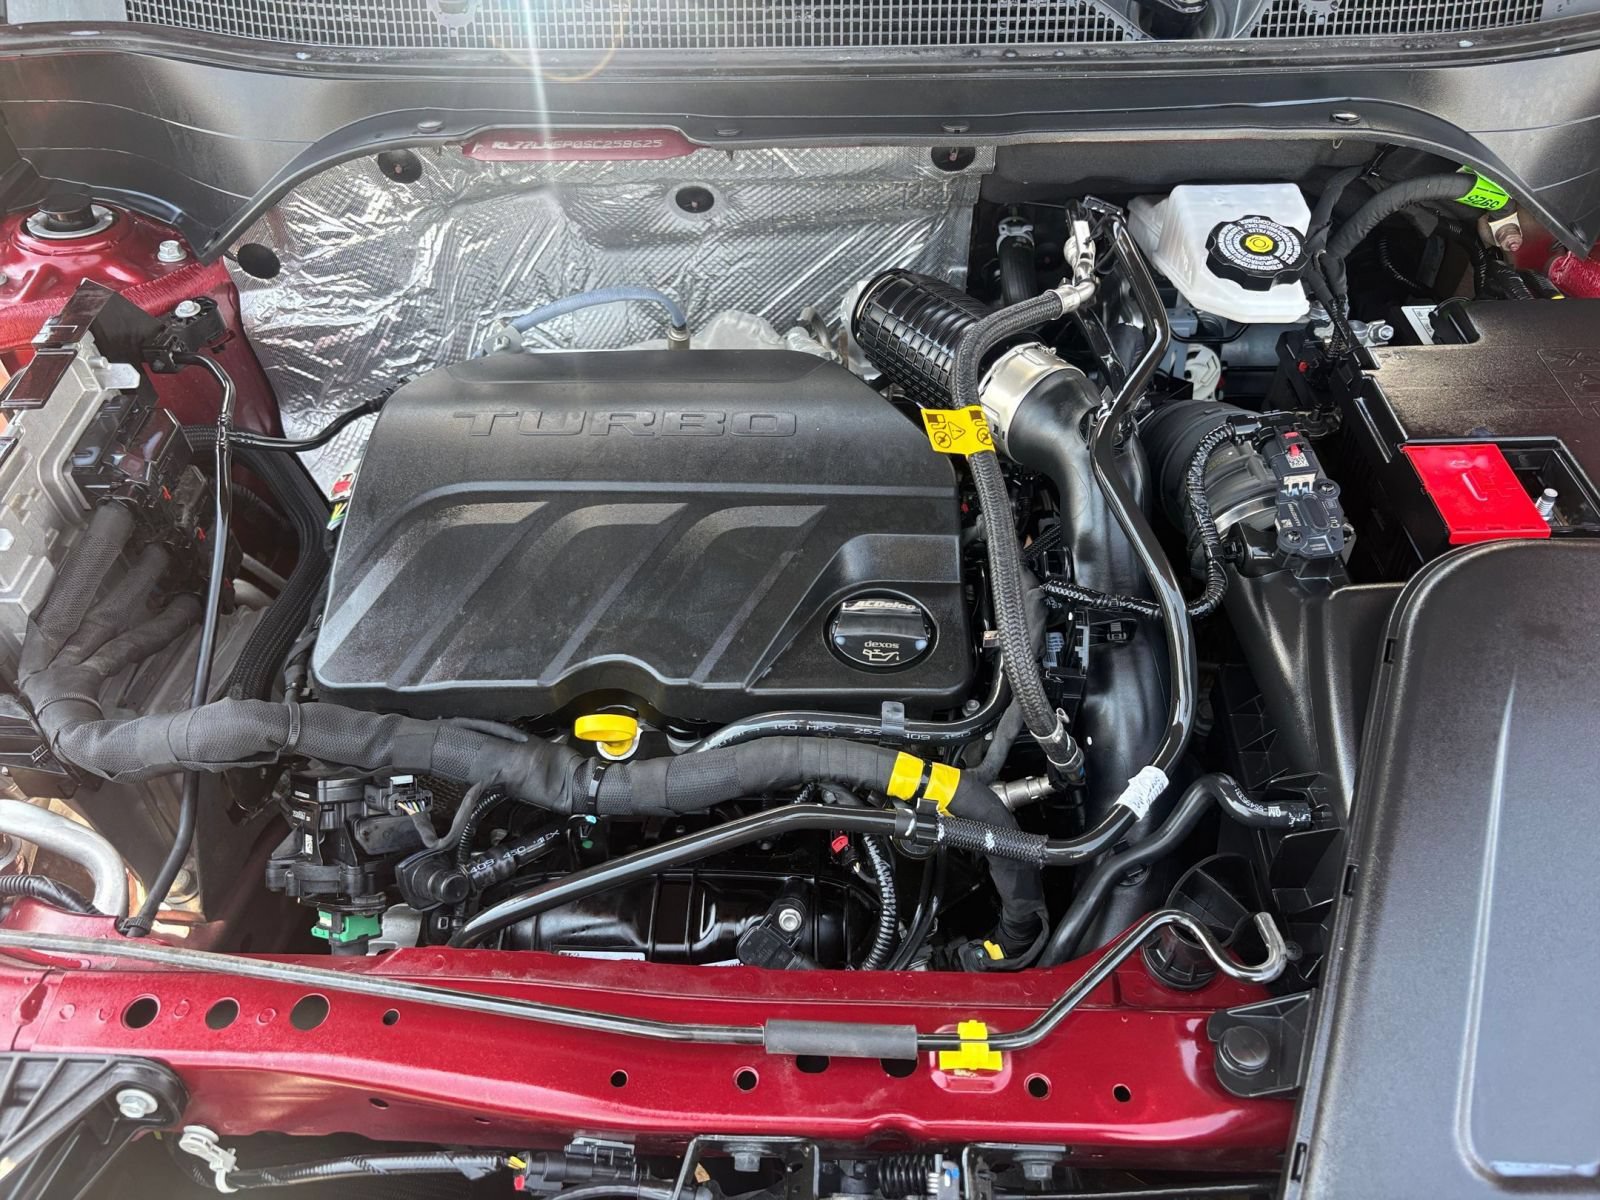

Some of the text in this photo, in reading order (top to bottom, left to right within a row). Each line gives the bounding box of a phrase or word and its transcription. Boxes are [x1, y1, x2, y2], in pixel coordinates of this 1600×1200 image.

[453, 411, 797, 437] TURBO
[853, 600, 917, 610] ACDelco
[864, 640, 900, 649] dexos
